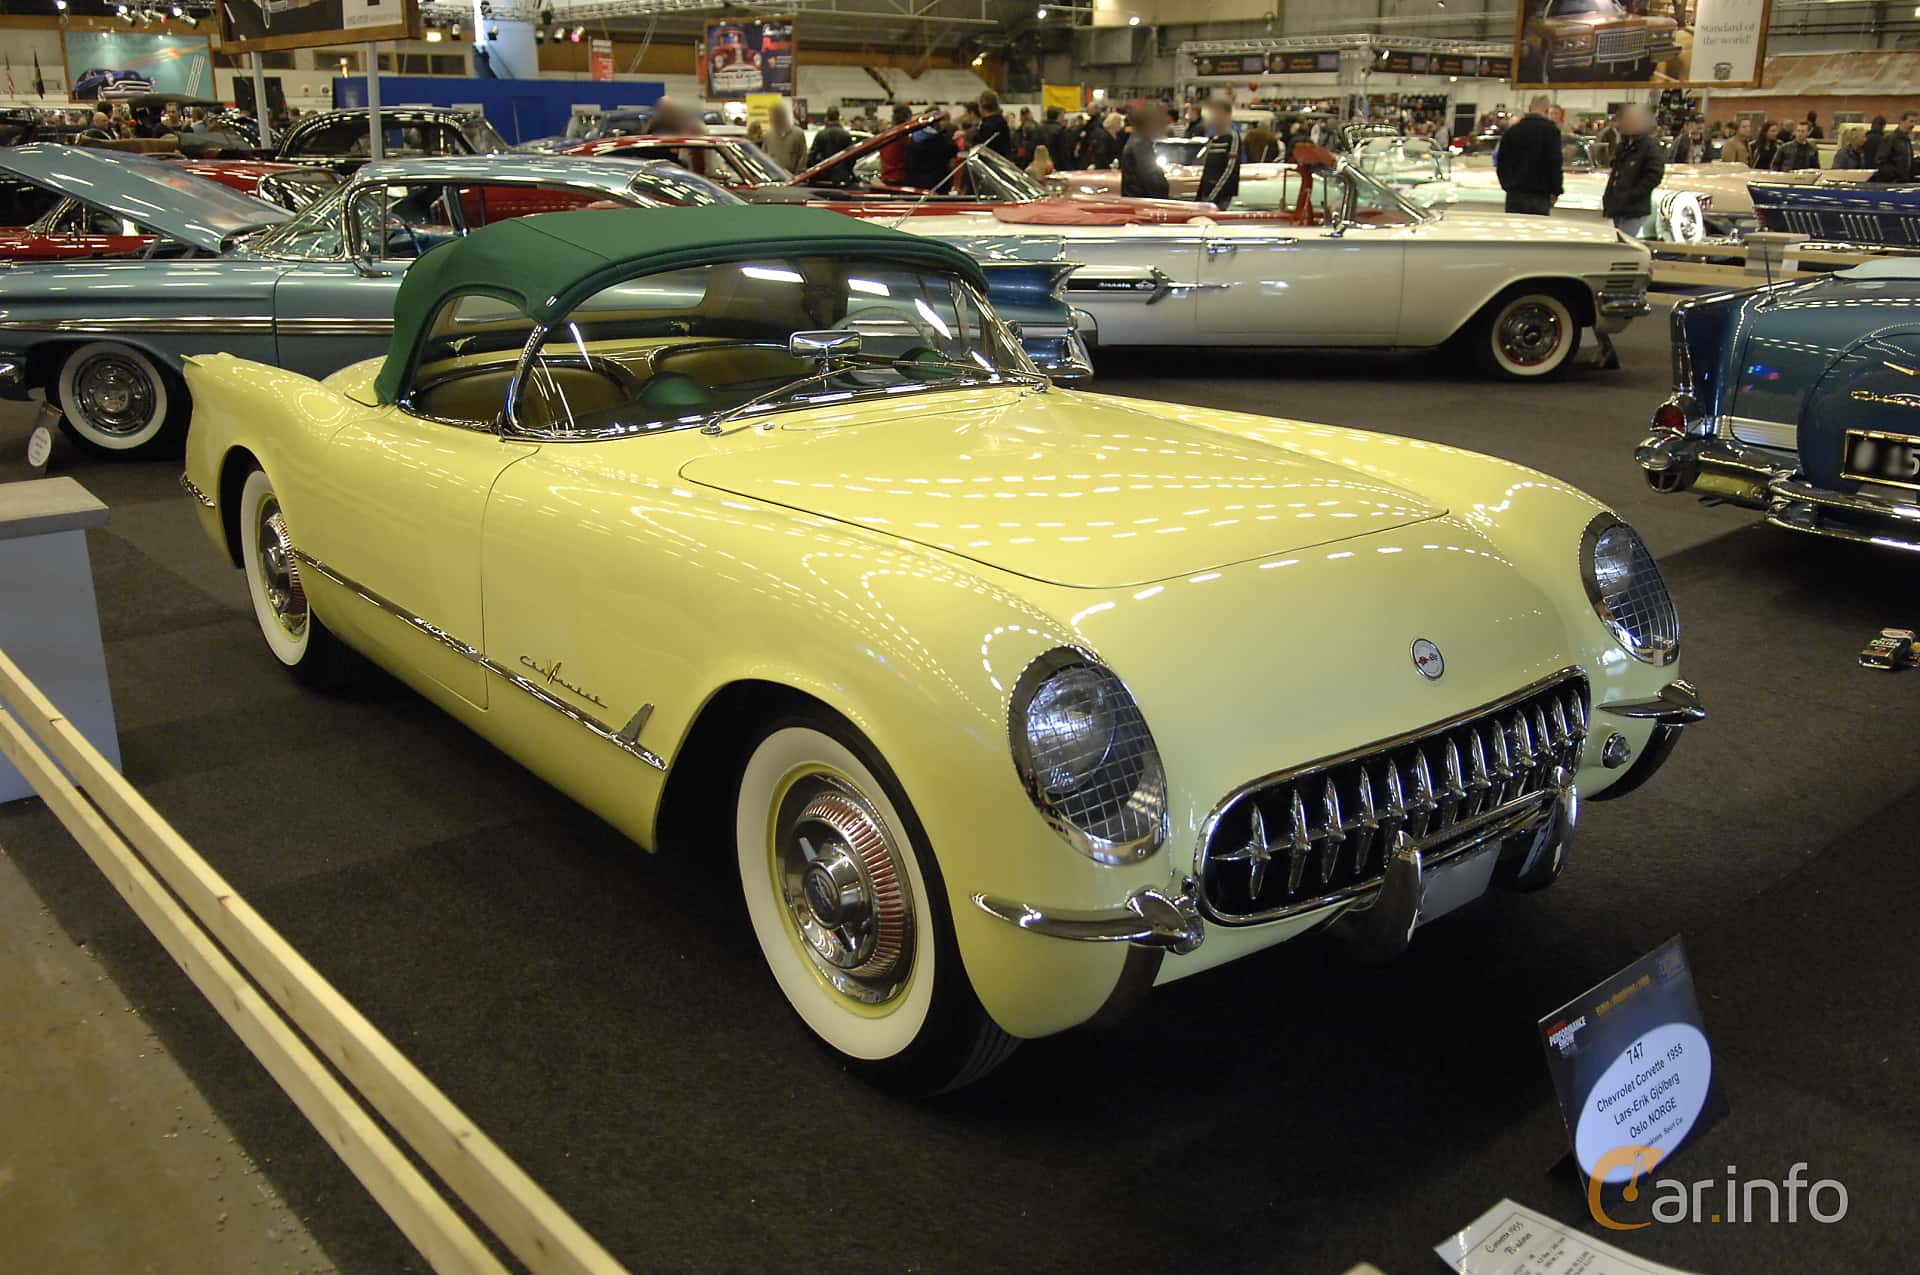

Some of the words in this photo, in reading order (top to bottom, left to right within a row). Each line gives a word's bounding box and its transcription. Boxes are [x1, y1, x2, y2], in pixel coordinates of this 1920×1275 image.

[1626, 1042, 1644, 1064] 747
[1597, 1080, 1636, 1113] Chevrolet
[1635, 1059, 1665, 1087] Corvette
[1666, 1043, 1684, 1062] 1955
[1614, 1096, 1650, 1126] Lars-Erik
[1629, 1120, 1648, 1139] Oslo
[1648, 1096, 1678, 1126] NORGE
